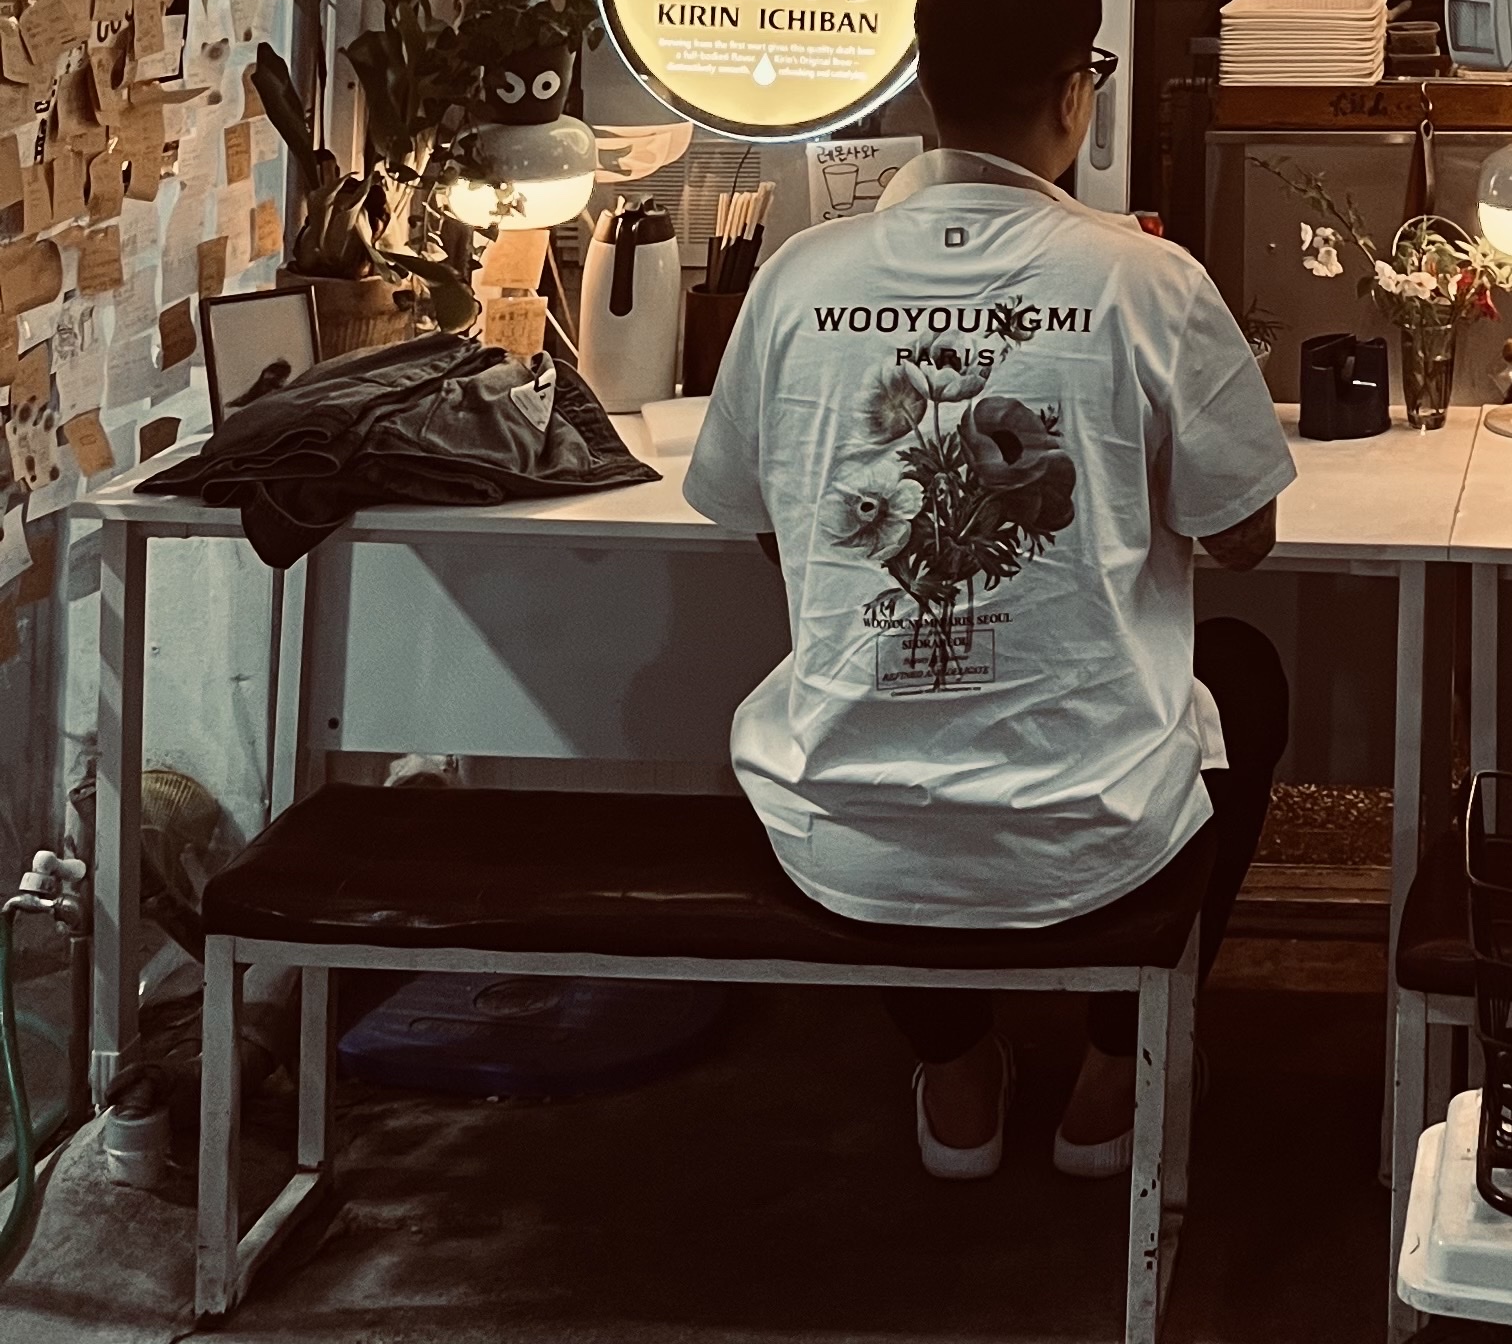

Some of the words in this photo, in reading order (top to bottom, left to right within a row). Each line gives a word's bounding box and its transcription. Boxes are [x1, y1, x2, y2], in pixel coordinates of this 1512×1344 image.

[658, 3, 739, 27] KIRIN
[760, 8, 878, 33] ICHIBAN
[817, 145, 879, 164] 레몬사와
[815, 306, 1092, 334] WOOYOUNGMI
